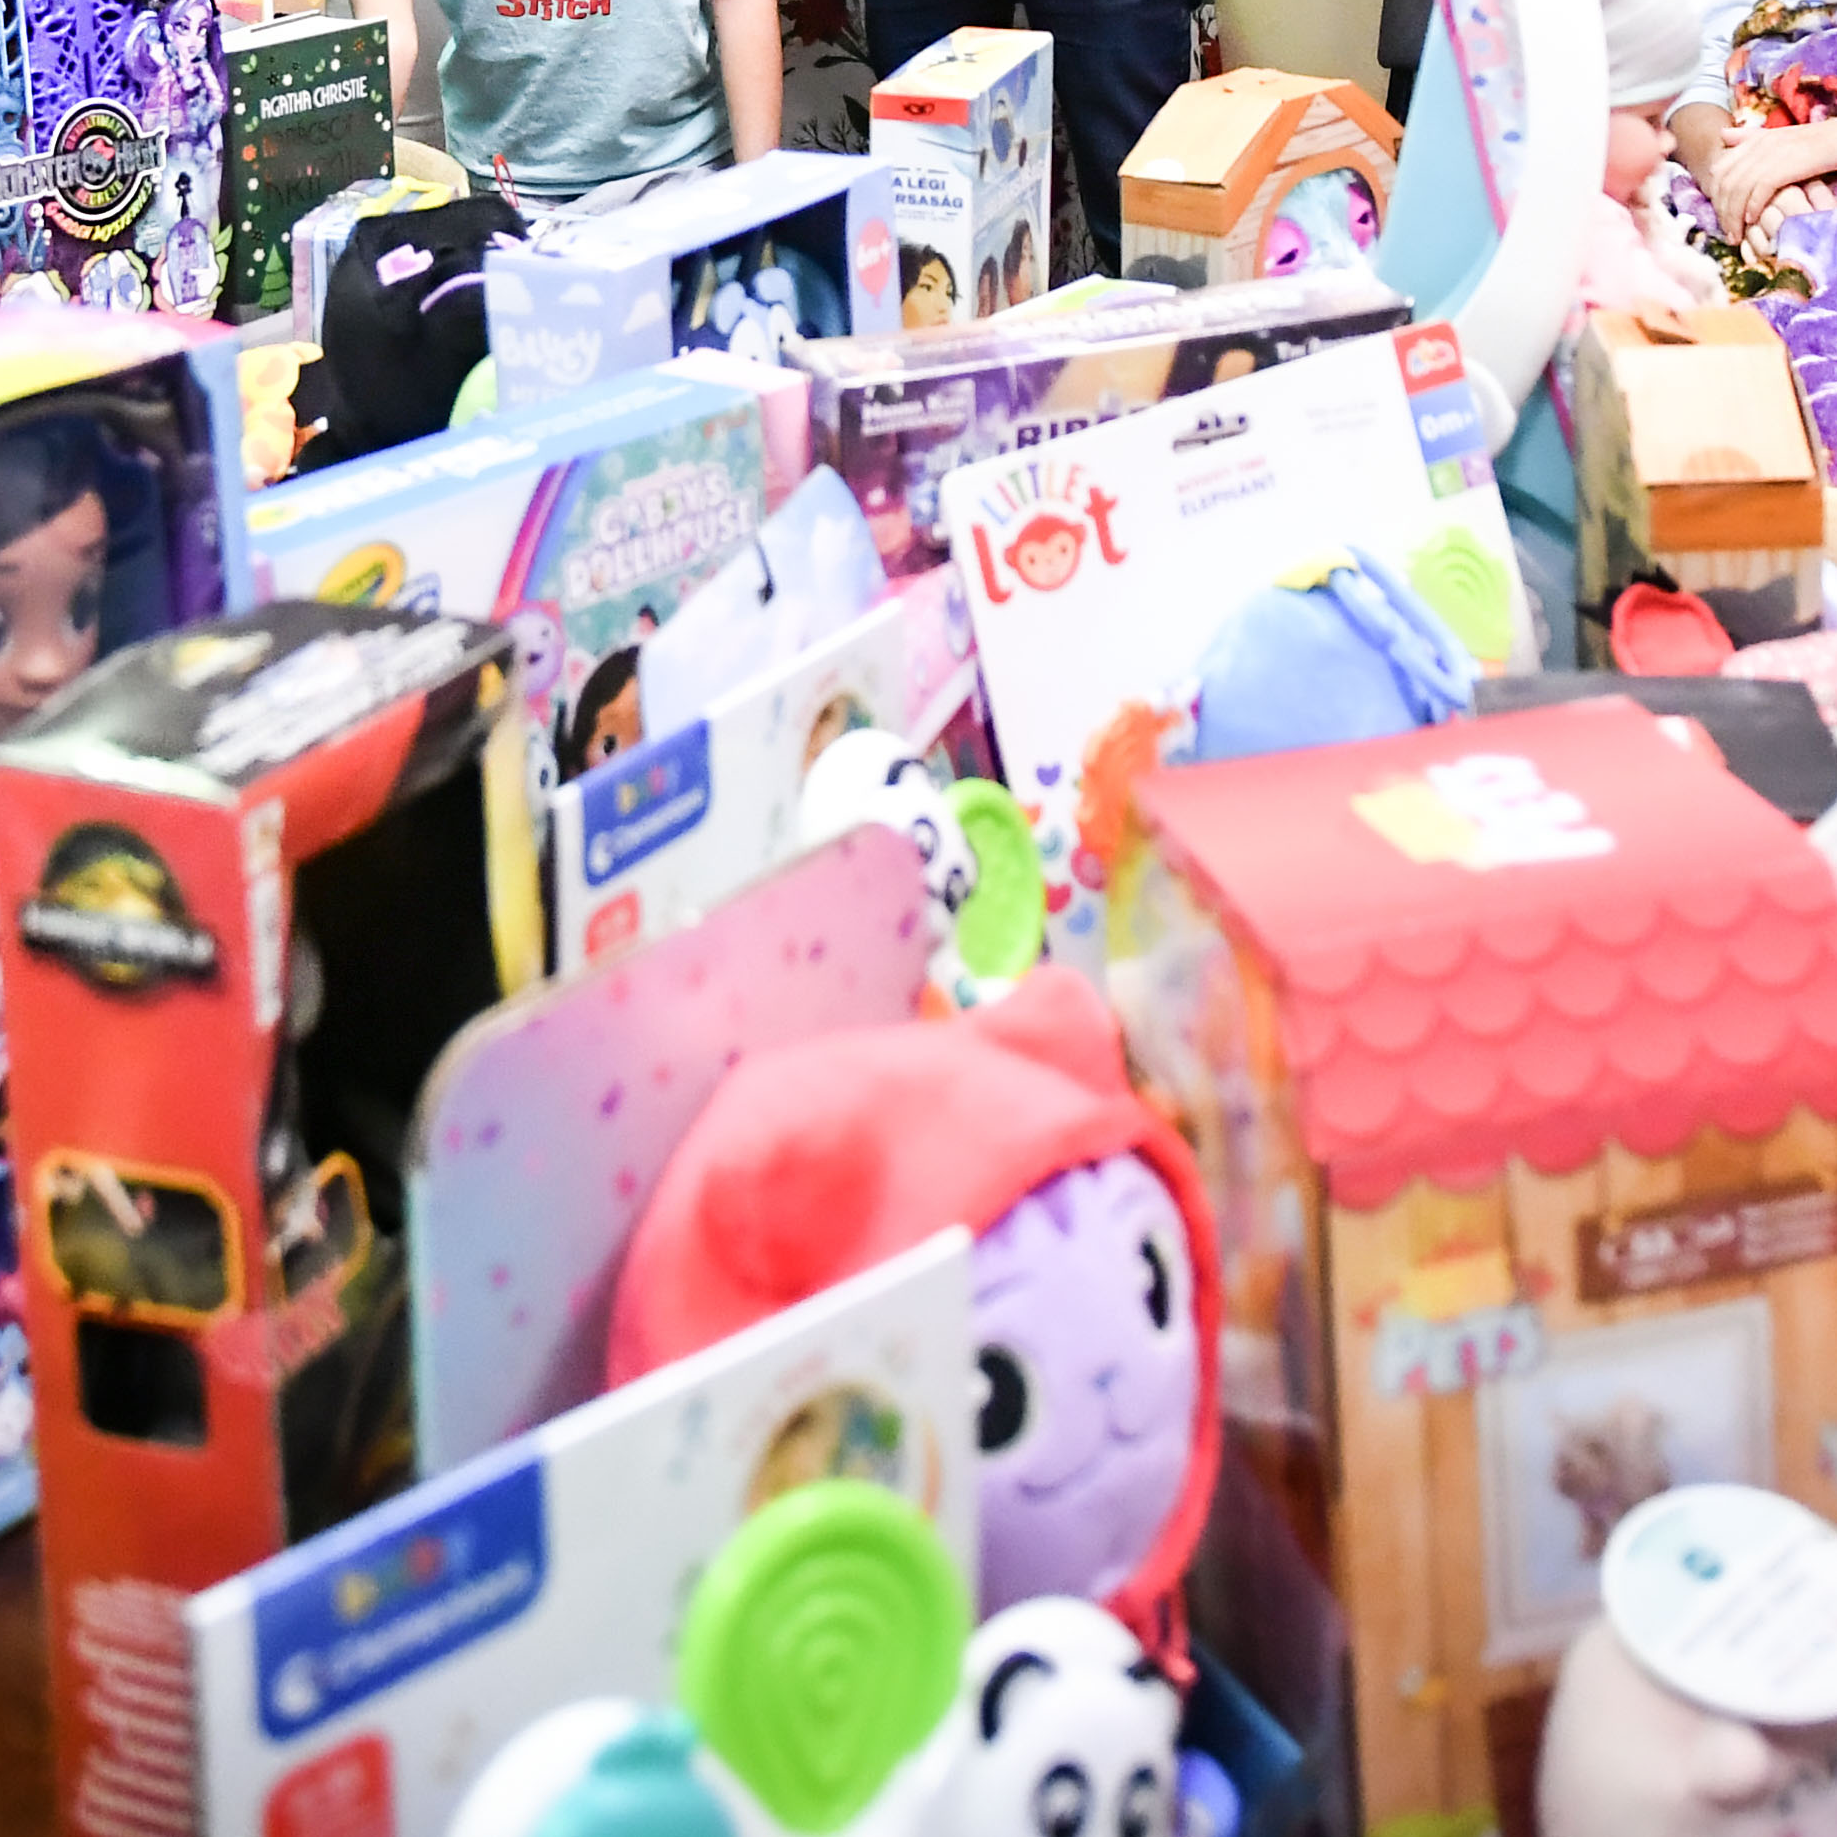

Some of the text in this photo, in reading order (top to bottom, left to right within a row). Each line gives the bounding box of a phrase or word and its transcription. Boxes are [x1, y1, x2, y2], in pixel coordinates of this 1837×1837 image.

[260, 75, 369, 120] AGATHA CHRISTIE
[113, 132, 162, 177] HIGH
[907, 176, 946, 191] LÉGI
[895, 193, 963, 209] RSASÁG
